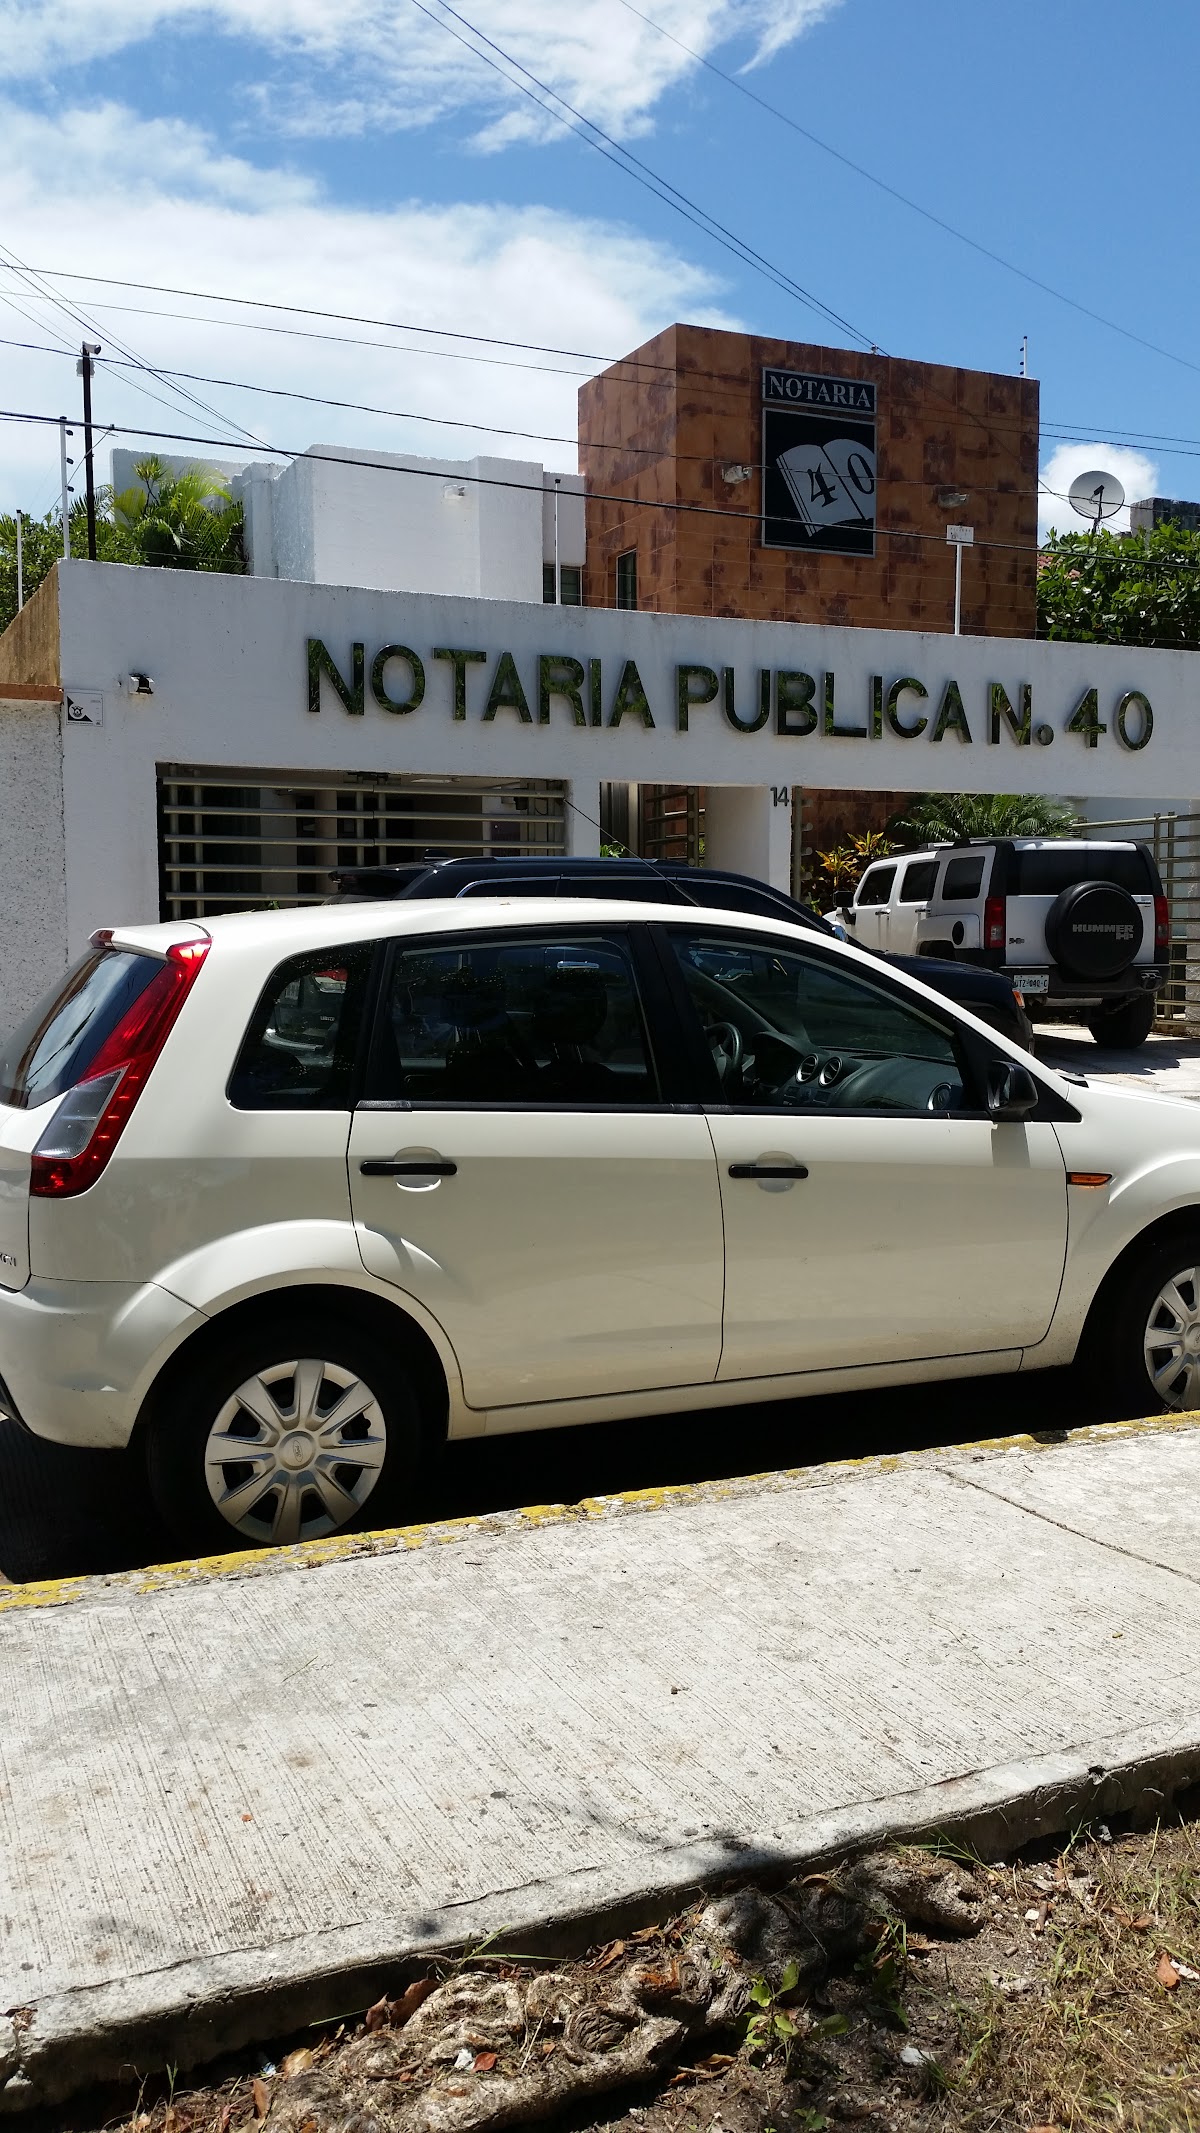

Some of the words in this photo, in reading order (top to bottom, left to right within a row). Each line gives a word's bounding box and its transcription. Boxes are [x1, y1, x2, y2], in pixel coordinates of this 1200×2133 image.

[769, 375, 872, 408] NOTARIA
[305, 638, 656, 728] NOTARIA
[675, 664, 973, 744] PUBLICA
[1064, 688, 1154, 751] 40
[770, 786, 790, 807] 14
[1072, 924, 1134, 933] HUMMER
